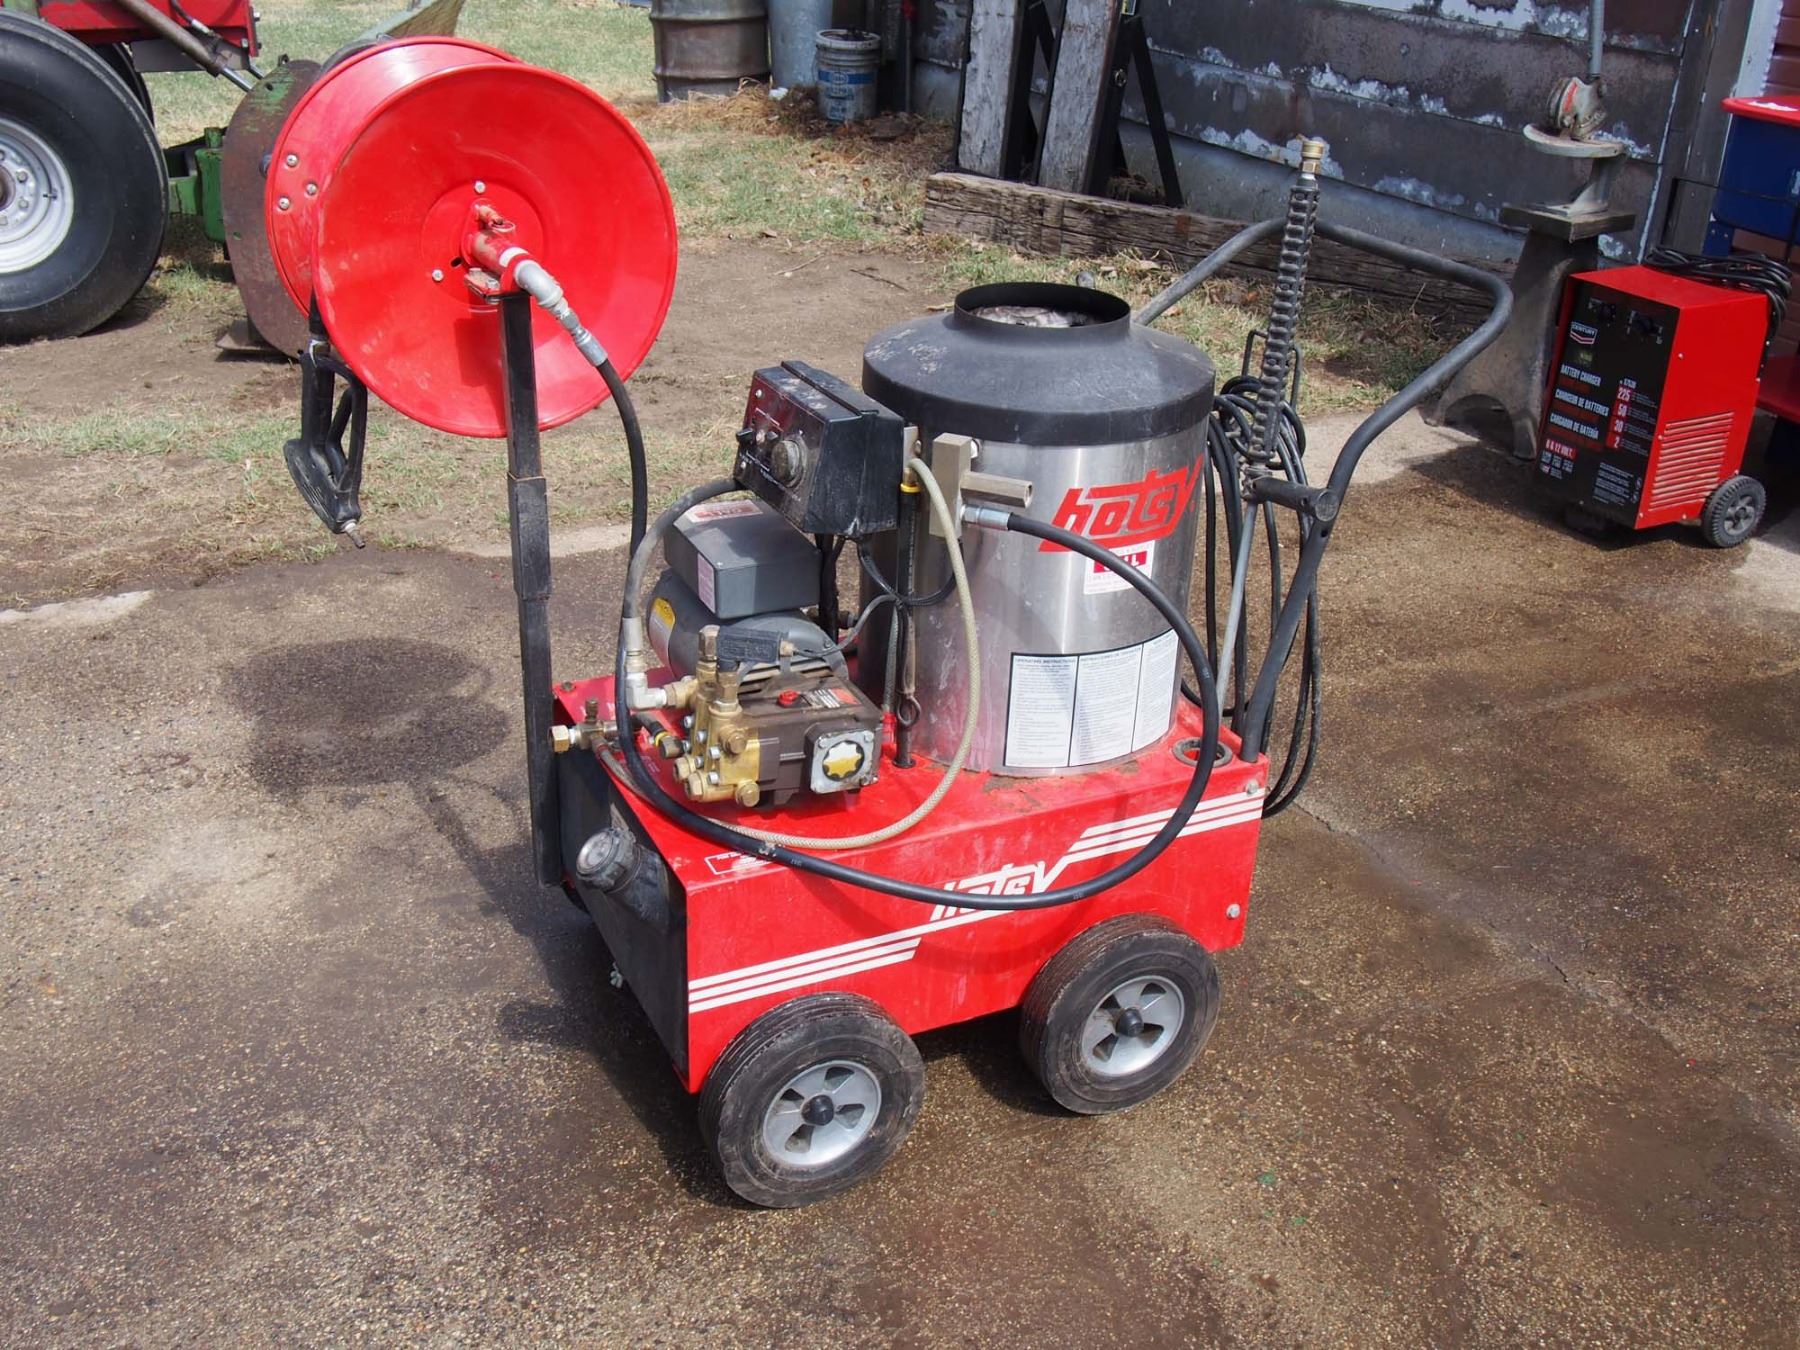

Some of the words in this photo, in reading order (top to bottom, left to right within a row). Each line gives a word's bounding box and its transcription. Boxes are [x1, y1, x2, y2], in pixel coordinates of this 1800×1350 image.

[1560, 364, 1581, 380] BATTERY
[1579, 370, 1602, 387] CHARGER
[1617, 386, 1632, 402] 225
[1577, 396, 1586, 408] DE
[1584, 399, 1609, 417] BATTERIES
[1617, 403, 1628, 417] 50
[1572, 421, 1581, 433] DE
